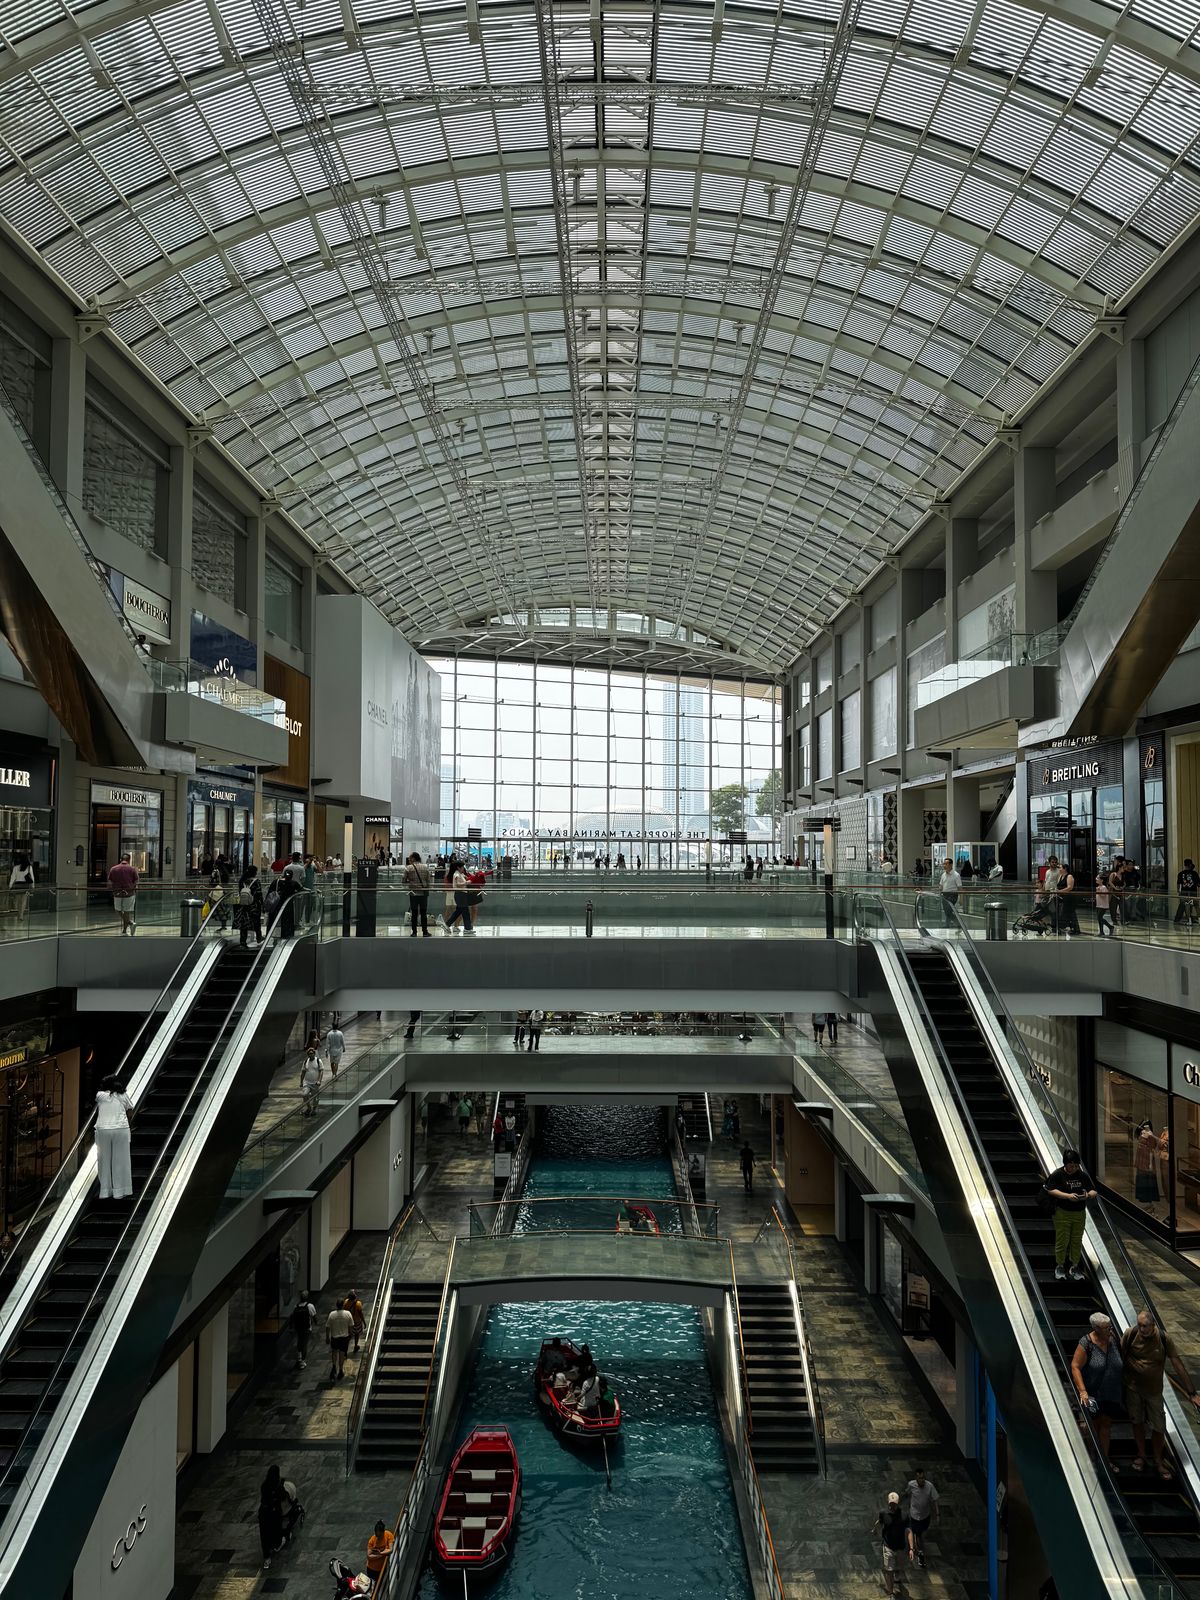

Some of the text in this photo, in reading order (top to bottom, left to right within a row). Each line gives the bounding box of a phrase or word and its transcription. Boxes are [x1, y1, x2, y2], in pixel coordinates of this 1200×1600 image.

[125, 591, 168, 624] BOUCHERON
[206, 682, 244, 707] CHAUMET
[368, 700, 388, 725] CHANEL
[0, 768, 30, 787] LLER
[1052, 762, 1099, 782] BREITLING
[110, 790, 147, 804] BOUCHERON
[209, 789, 237, 801] CHAUMET
[364, 867, 369, 877] 1
[1183, 1062, 1200, 1084] Ch
[111, 1503, 147, 1571] COS
